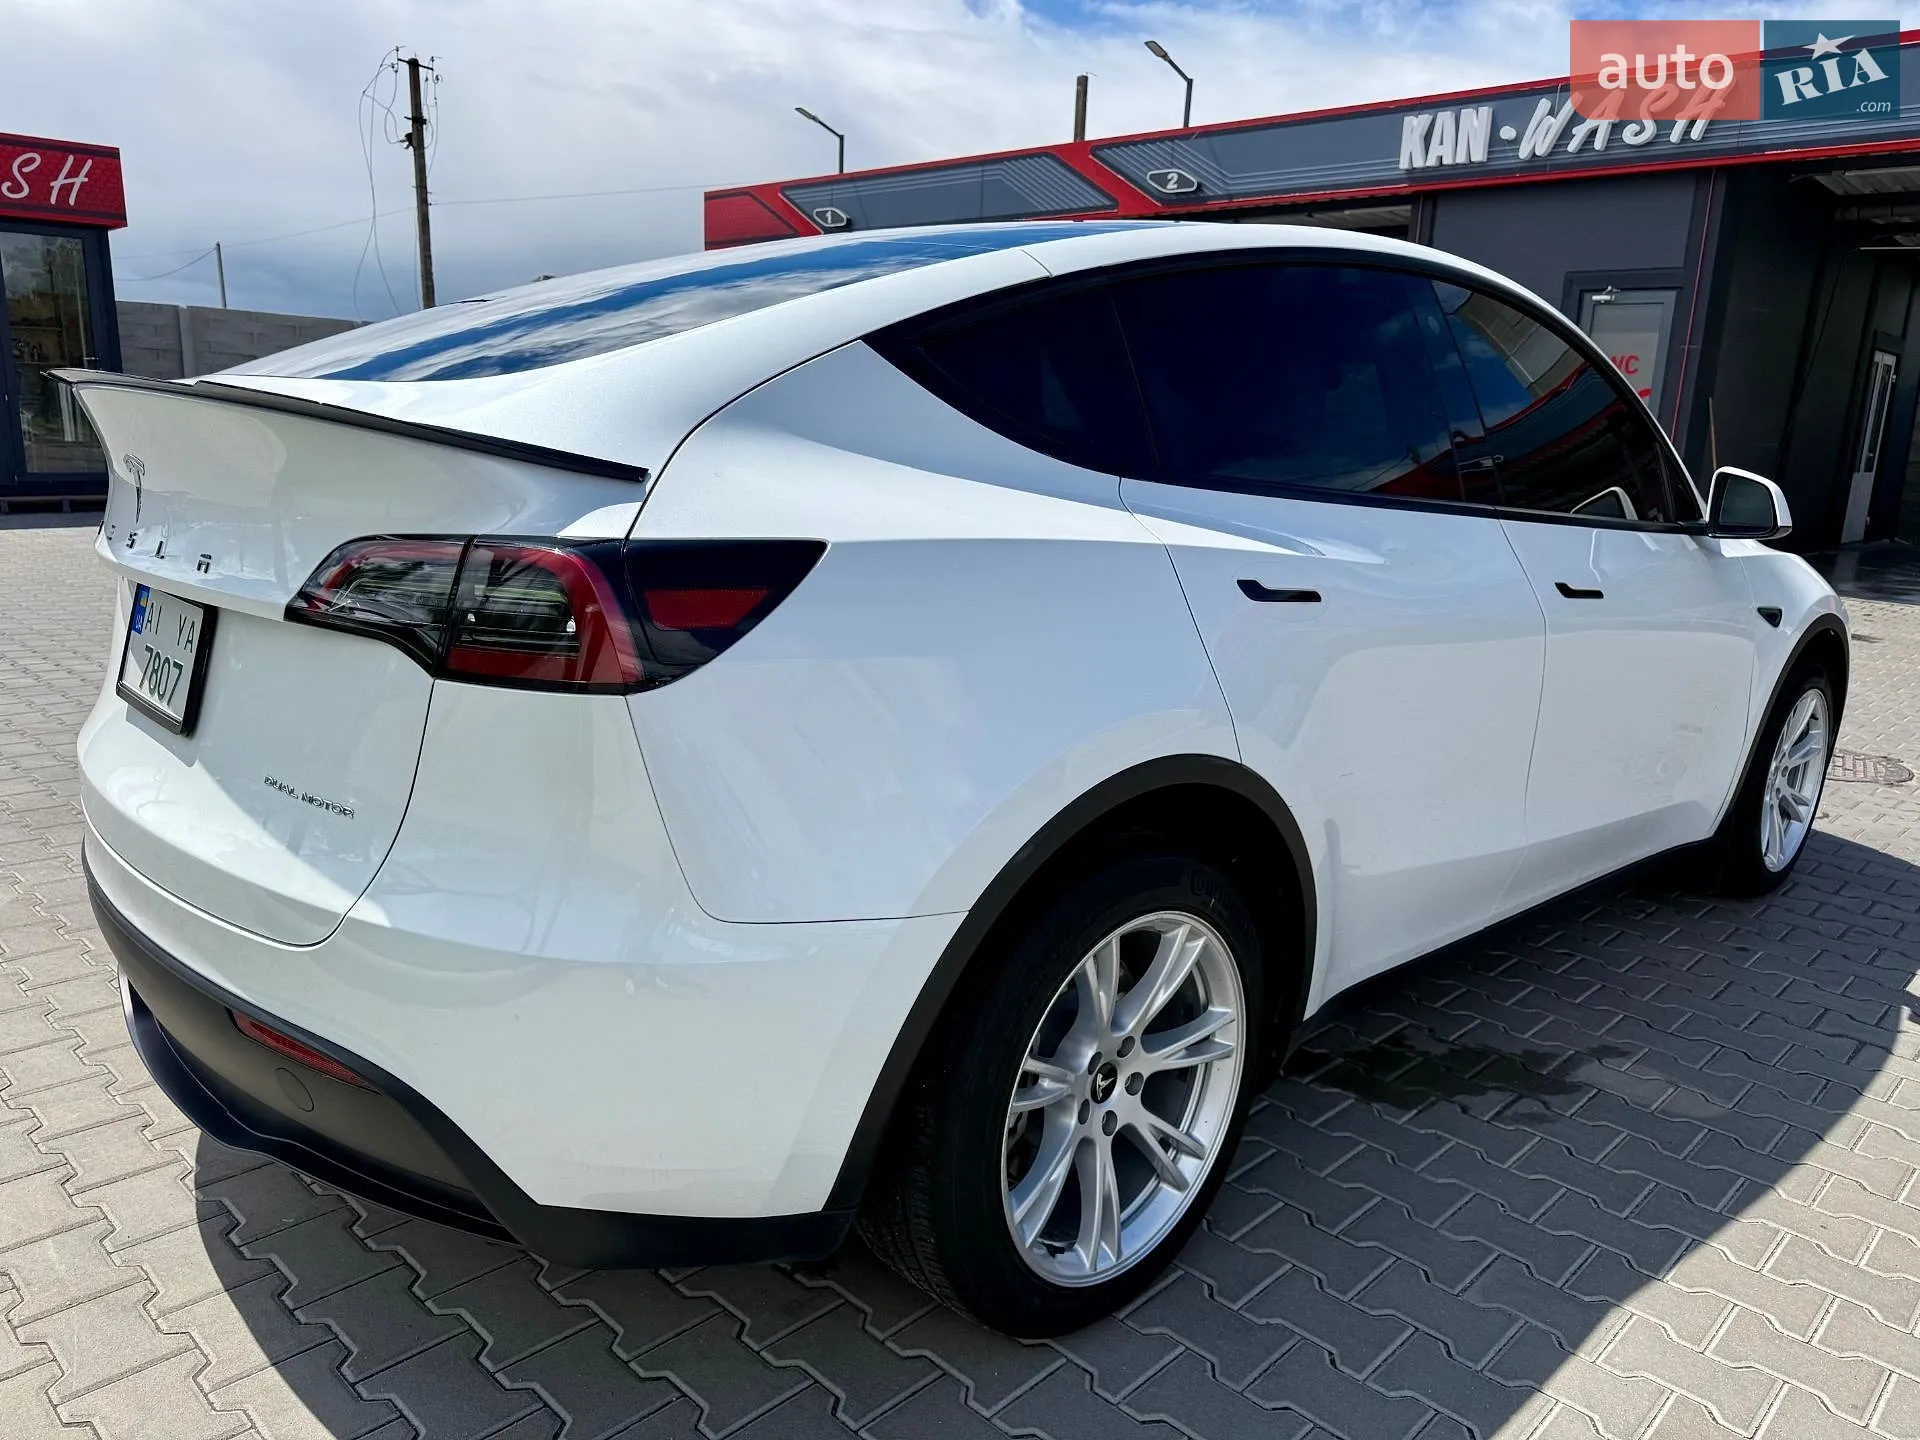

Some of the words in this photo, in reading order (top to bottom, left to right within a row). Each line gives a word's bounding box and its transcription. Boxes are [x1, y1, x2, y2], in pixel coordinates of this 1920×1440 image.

[1399, 106, 1493, 170] KAN
[1518, 74, 1737, 160] WASH
[1166, 172, 1179, 190] 2
[144, 602, 162, 635] AI
[176, 614, 196, 654] YA
[138, 645, 184, 706] 7807
[264, 775, 299, 799] DUAL
[301, 791, 355, 819] MOTOR
